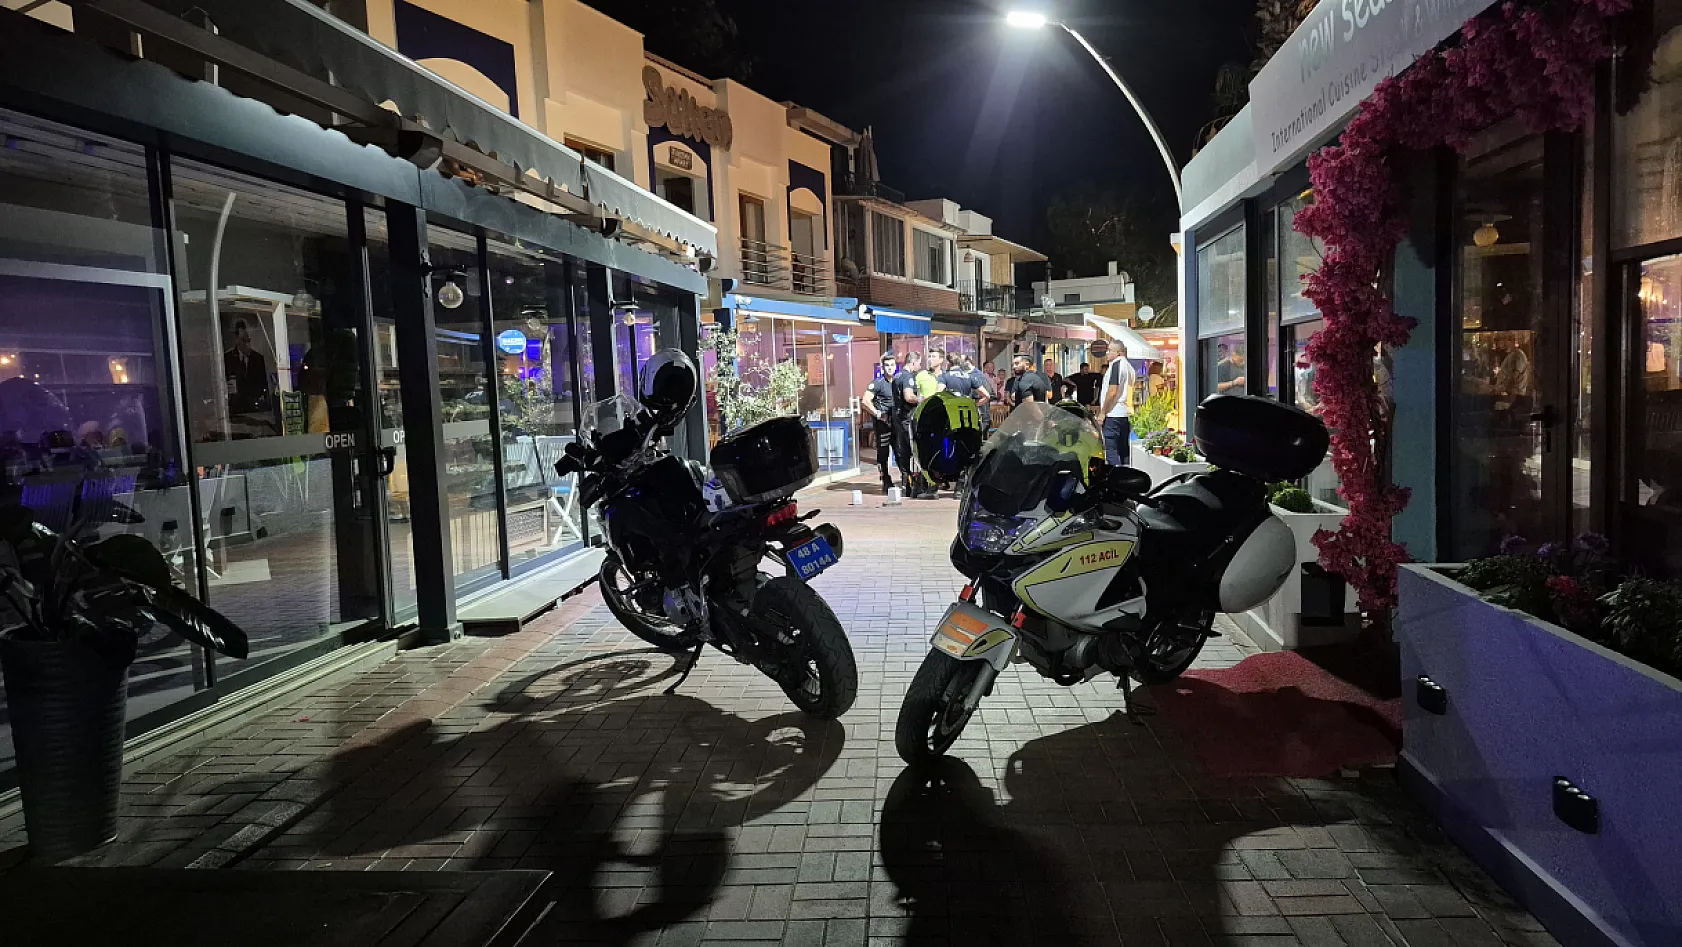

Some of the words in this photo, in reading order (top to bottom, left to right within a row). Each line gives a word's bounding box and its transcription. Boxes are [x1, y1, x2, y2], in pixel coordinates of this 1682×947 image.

[1271, 86, 1327, 153] International
[1328, 61, 1368, 107] Cuisine
[325, 432, 356, 449] OPEN
[393, 430, 406, 444] OP
[797, 546, 811, 559] 48
[811, 542, 821, 553] A
[1080, 553, 1097, 565] 112
